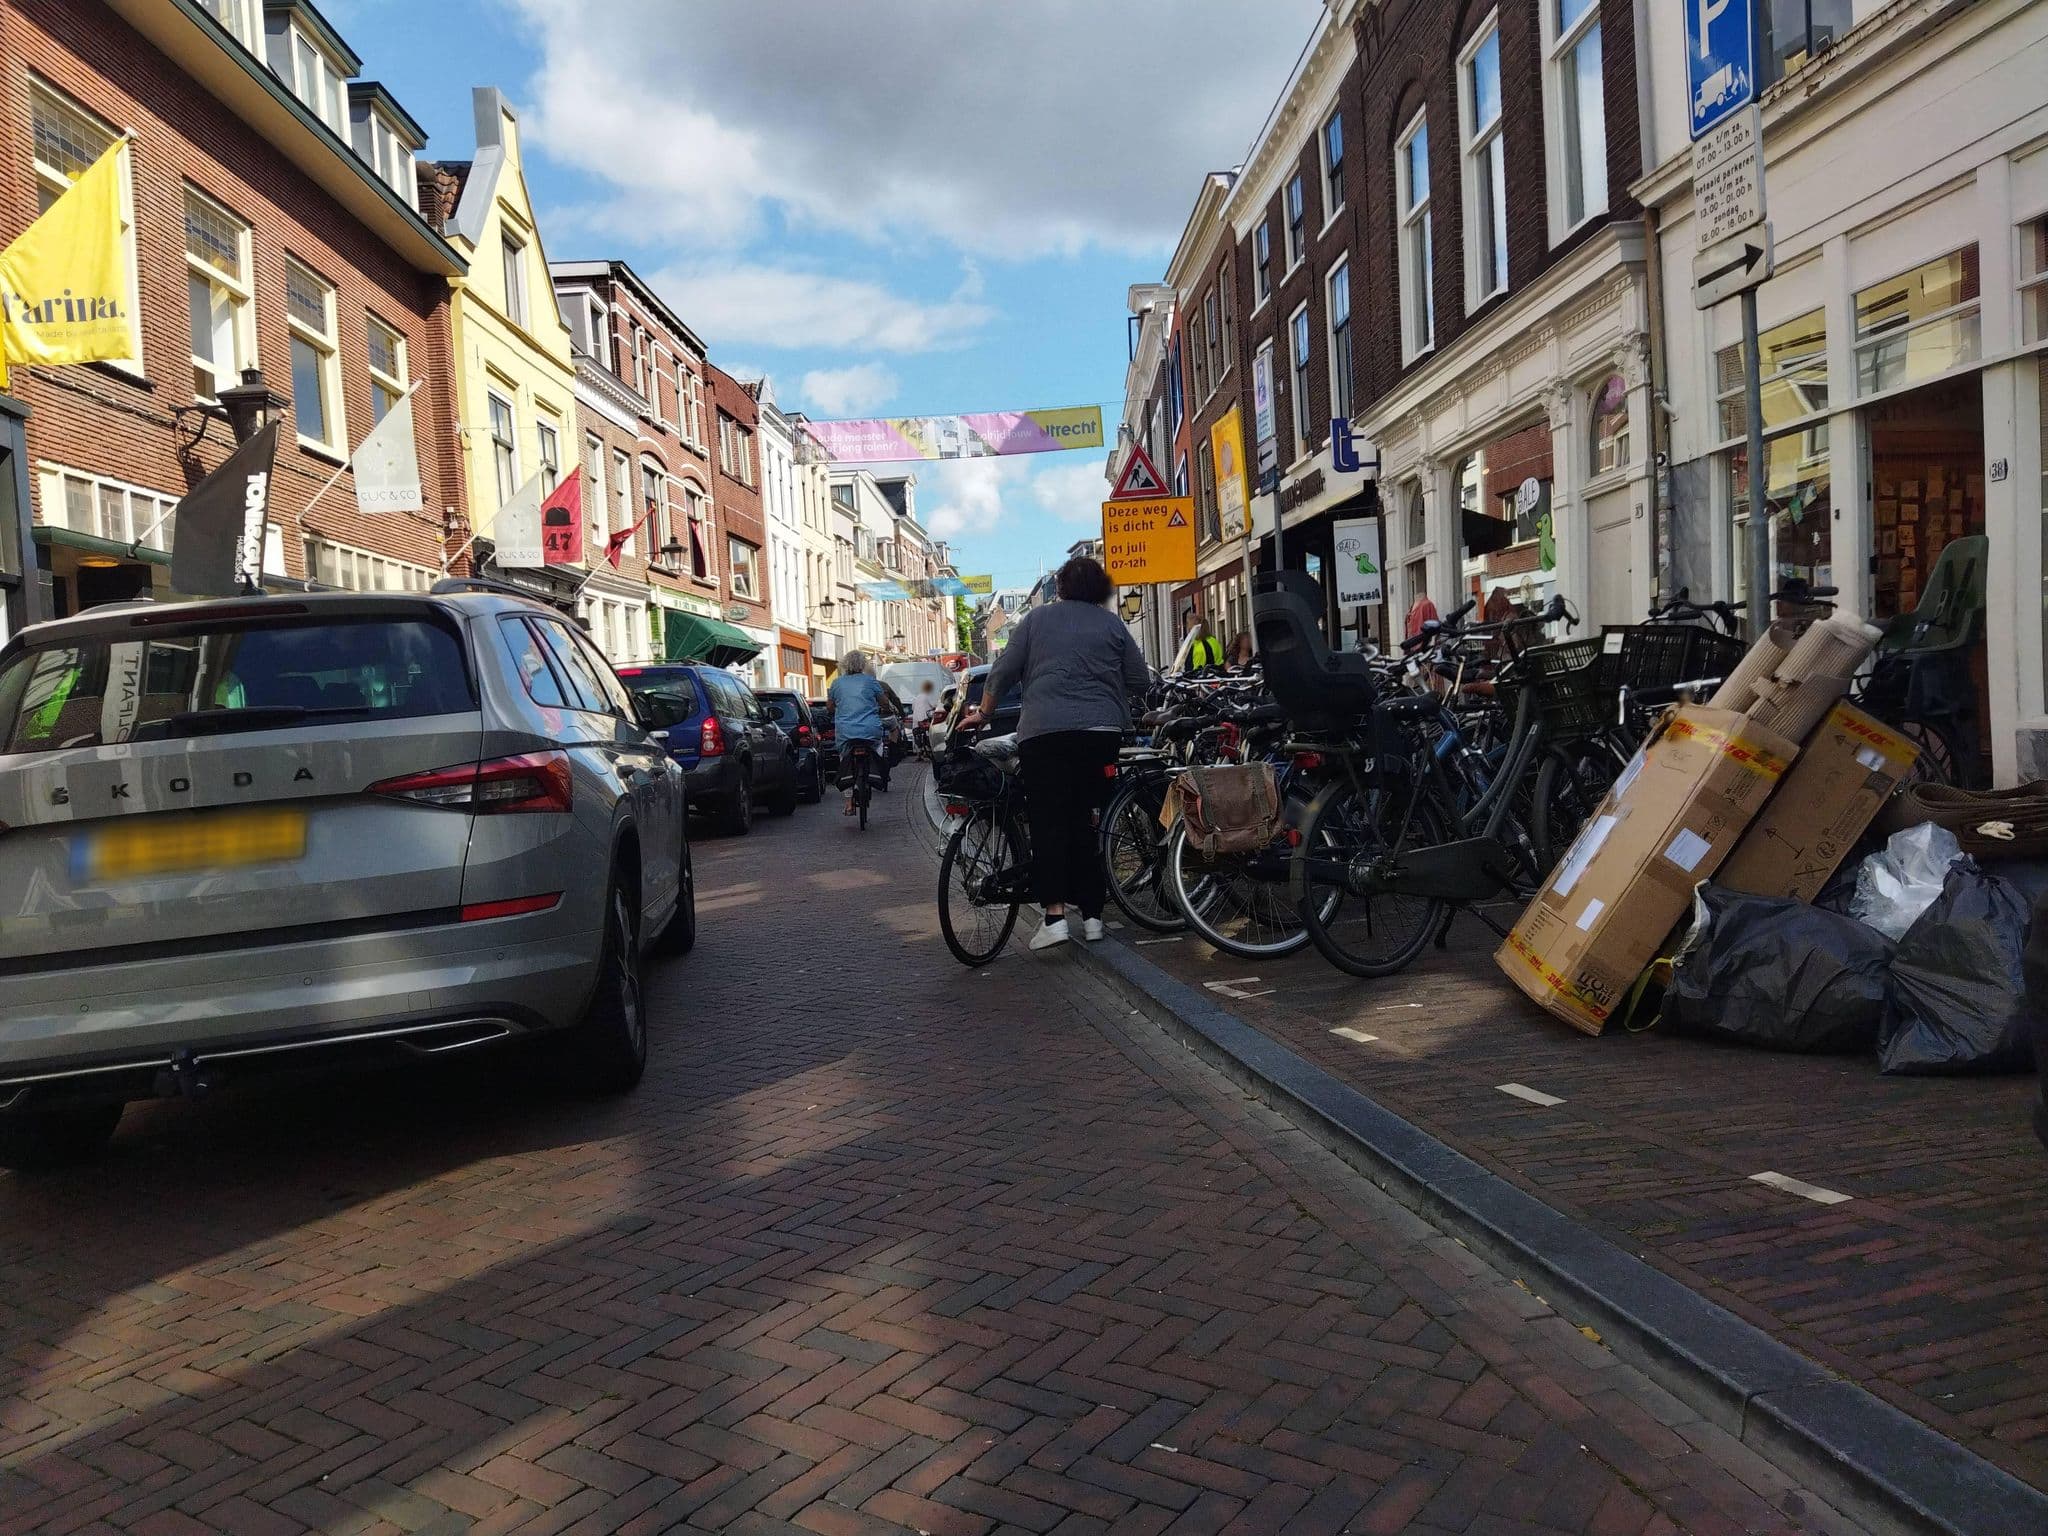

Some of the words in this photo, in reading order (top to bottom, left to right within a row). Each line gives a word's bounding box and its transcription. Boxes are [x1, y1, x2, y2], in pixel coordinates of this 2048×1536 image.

[1699, 0, 1729, 60] P
[1716, 130, 1730, 143] t/m
[1697, 151, 1716, 170] 07.00
[1724, 132, 1743, 152] 13.00
[1745, 129, 1750, 138] h
[1696, 175, 1720, 196] betaald
[1722, 154, 1755, 181] parkeren
[1719, 181, 1733, 195] t/m
[1700, 201, 1718, 220] 13.00
[1726, 185, 1746, 203] 01.00
[1747, 182, 1753, 192] h
[1714, 204, 1739, 224] zondag
[1701, 226, 1720, 244] 12.00
[1749, 208, 1754, 218] h
[1992, 462, 2003, 478] 38
[1517, 480, 1536, 506] SALE
[1108, 507, 1138, 517] Deze
[1143, 505, 1168, 516] weg
[1109, 522, 1119, 533] is
[1123, 520, 1154, 532] dicht
[546, 532, 573, 551] 47
[1111, 545, 1122, 554] 01
[1126, 541, 1146, 556] juli
[1111, 557, 1146, 569] 07-12h
